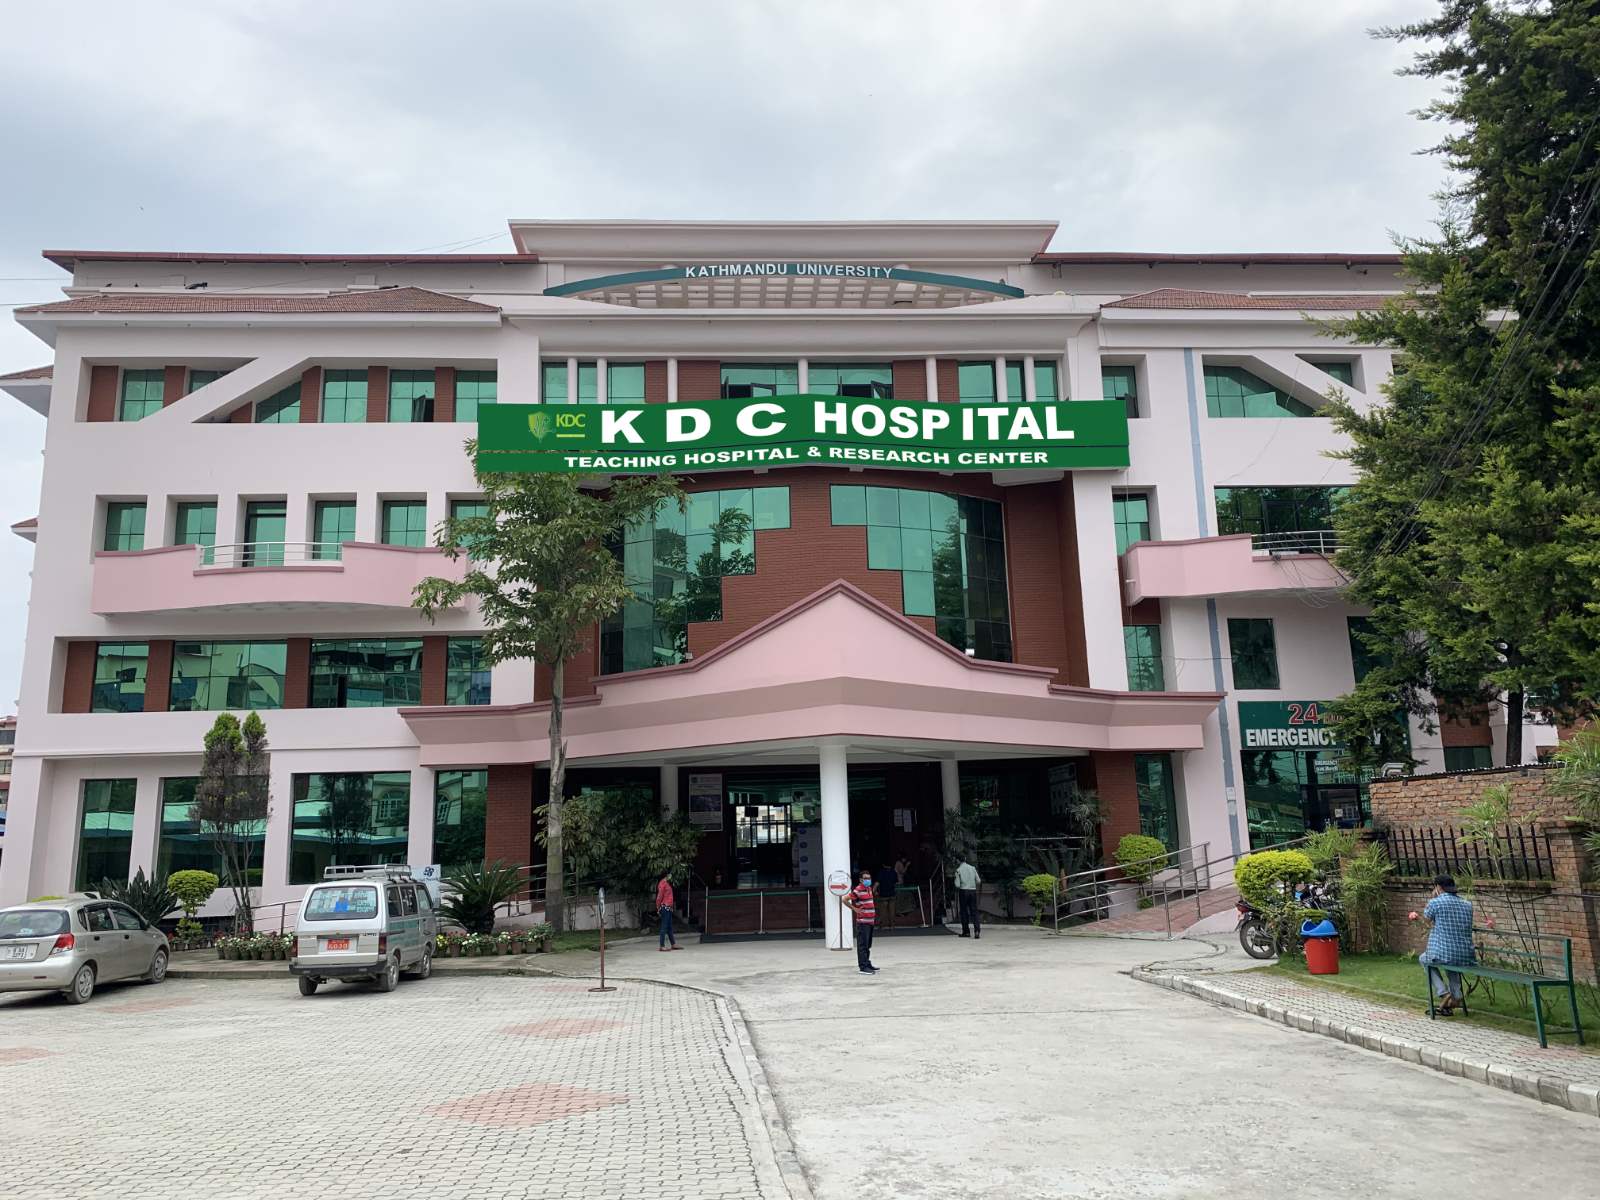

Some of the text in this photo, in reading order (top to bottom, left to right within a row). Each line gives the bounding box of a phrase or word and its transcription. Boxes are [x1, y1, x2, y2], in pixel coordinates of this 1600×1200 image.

[685, 263, 892, 279] KATHMANDU UNIVERSITY
[556, 413, 586, 428] KDC
[564, 446, 1049, 468] TEACHING HOSPITAL & RESEARCH CENTER
[1288, 703, 1319, 725] 24
